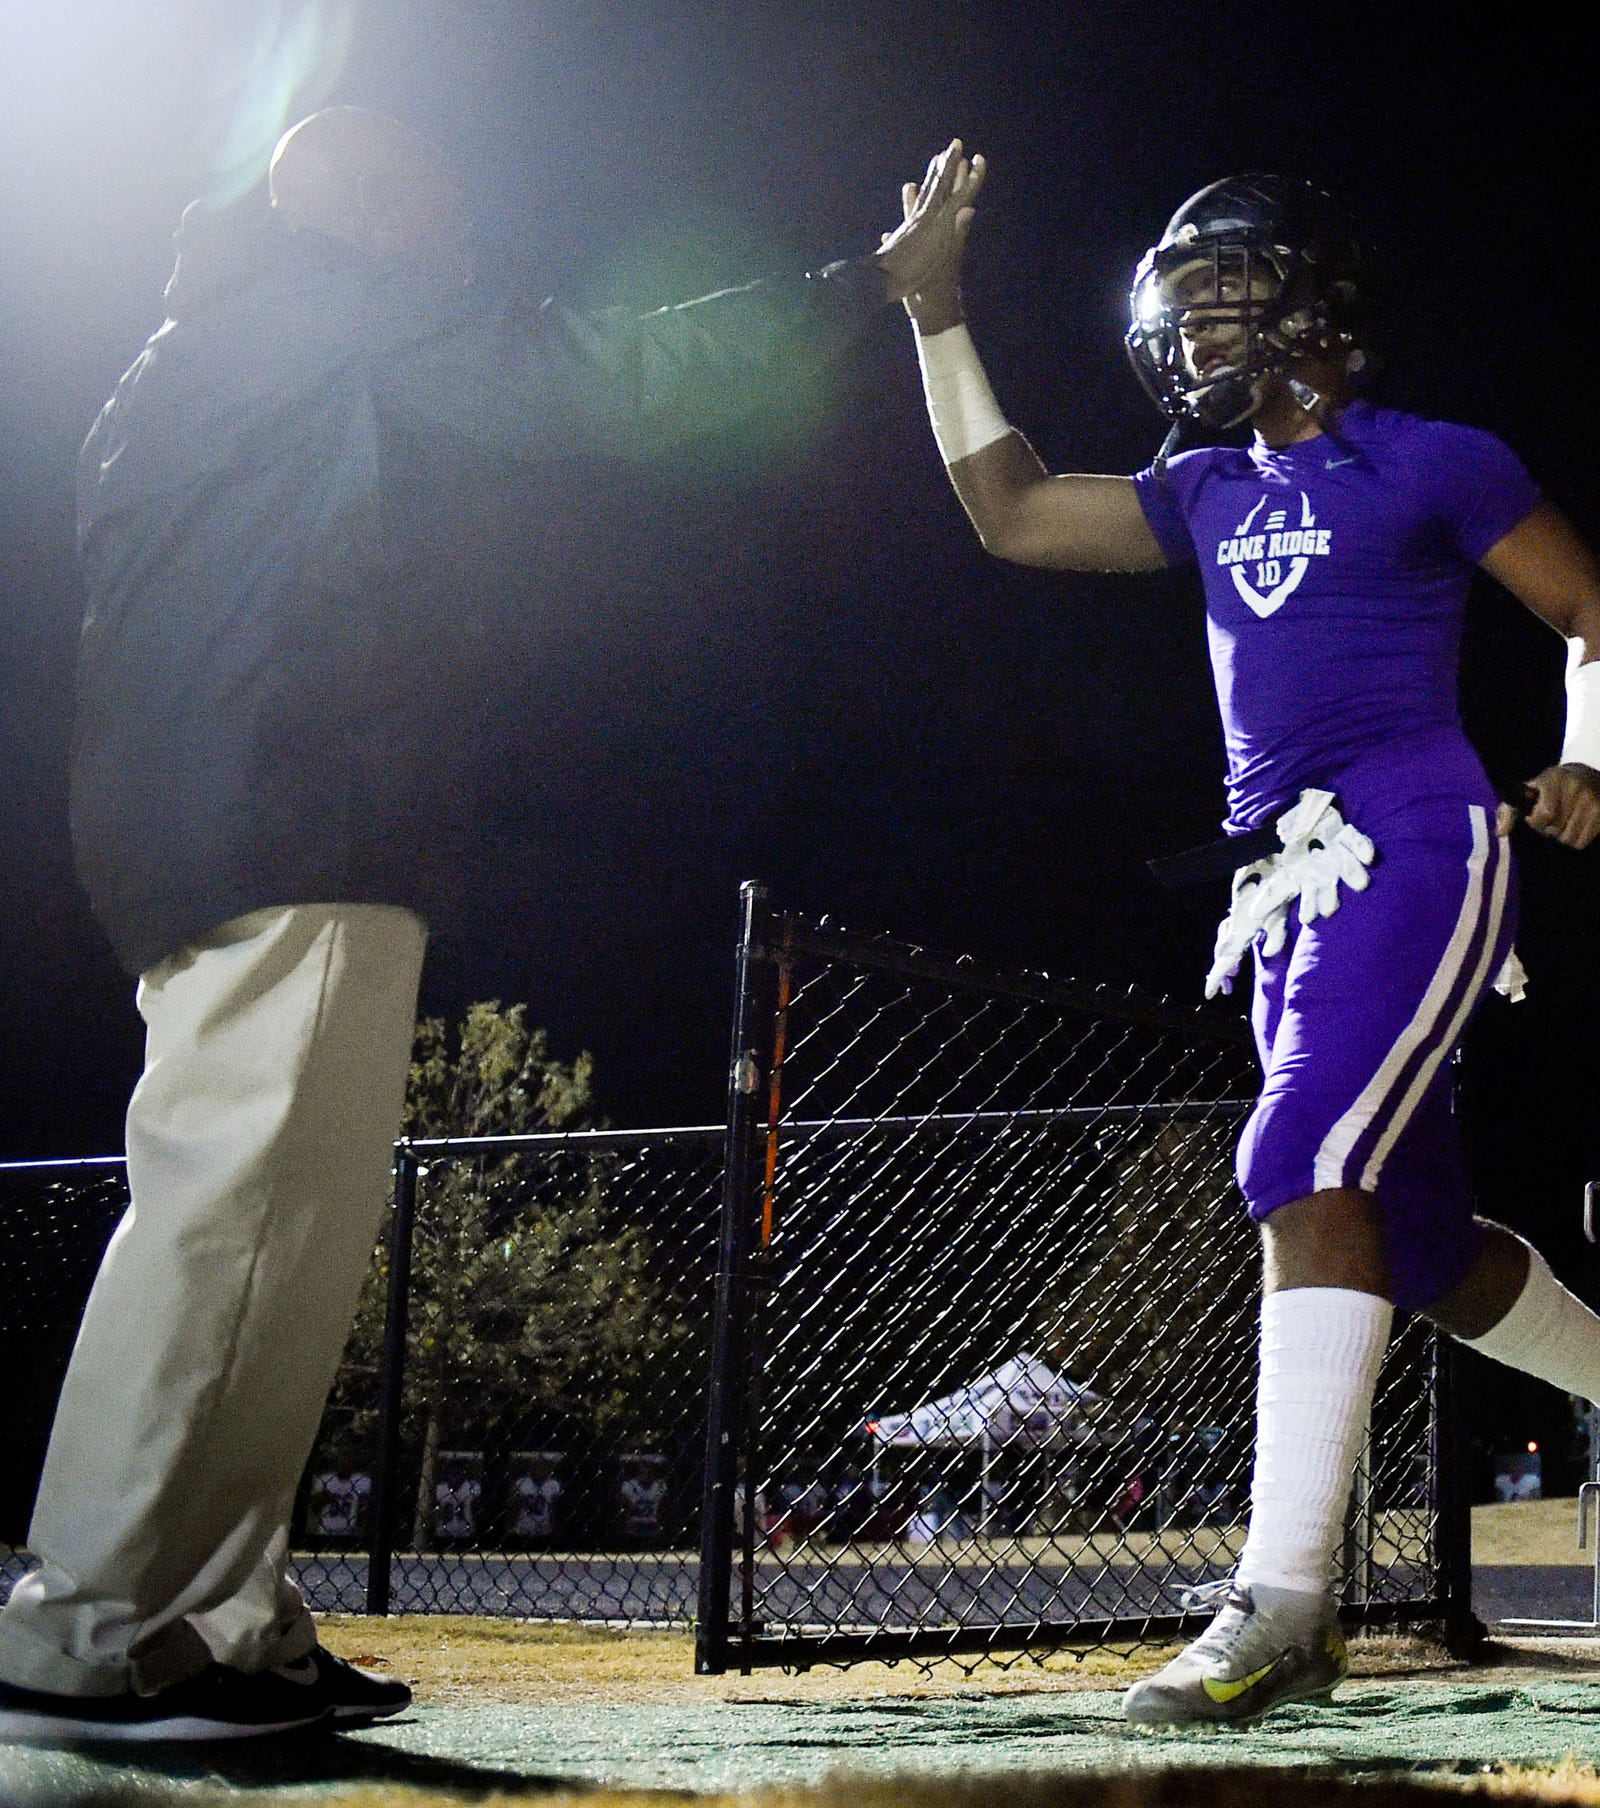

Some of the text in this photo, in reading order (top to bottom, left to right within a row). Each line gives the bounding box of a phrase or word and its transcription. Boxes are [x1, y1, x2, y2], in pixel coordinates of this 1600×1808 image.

[1217, 529, 1332, 566] CANE RIDGE
[1256, 559, 1281, 587] 10
